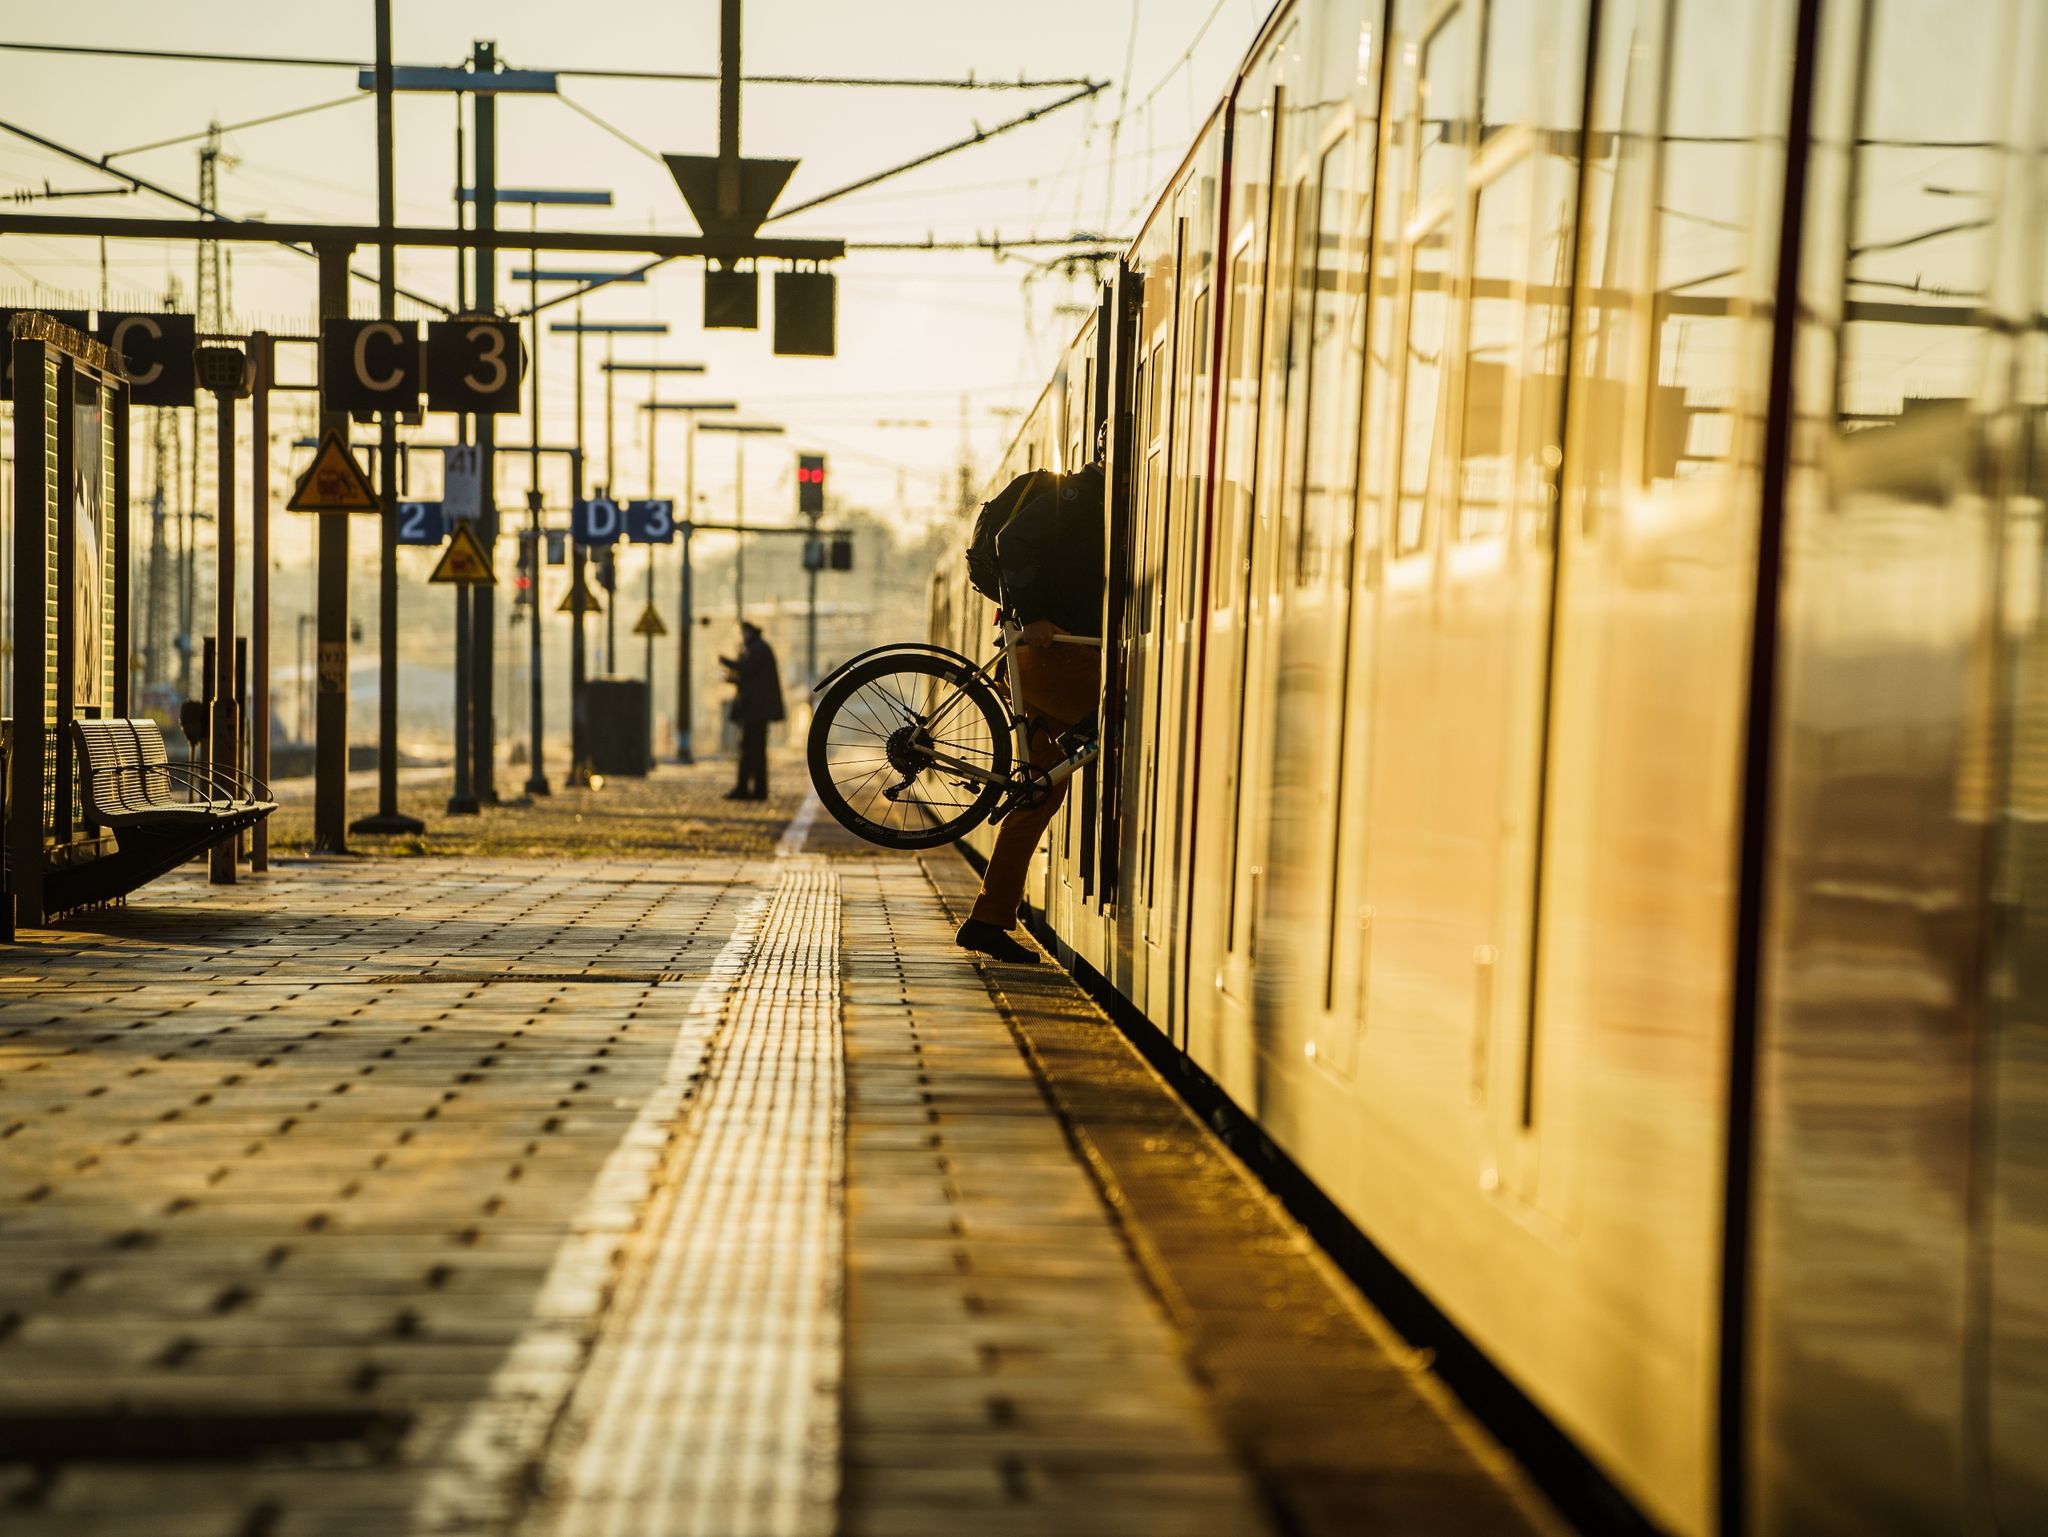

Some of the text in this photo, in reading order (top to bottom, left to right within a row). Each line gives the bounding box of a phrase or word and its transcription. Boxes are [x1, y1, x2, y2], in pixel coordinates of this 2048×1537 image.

[112, 316, 164, 386] C
[354, 322, 507, 394] C 3
[447, 448, 477, 477] 41
[400, 501, 426, 539] 2
[586, 500, 671, 537] D 3
